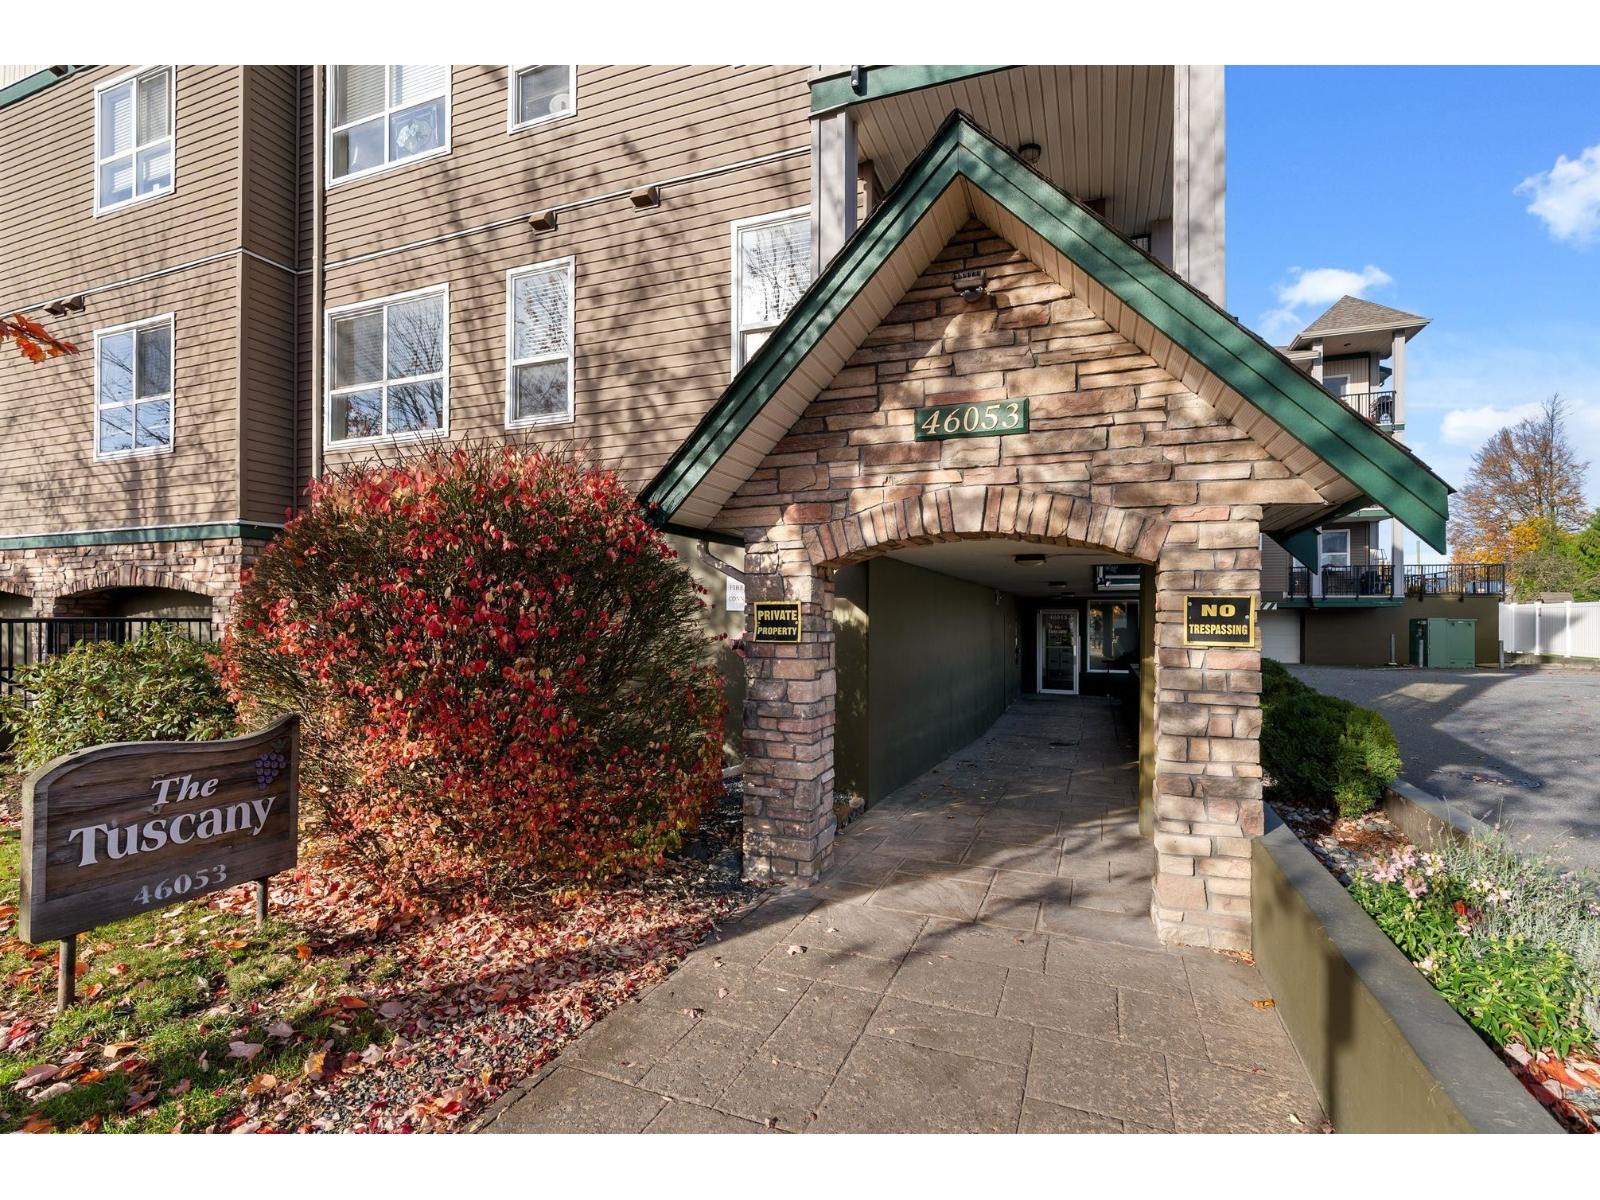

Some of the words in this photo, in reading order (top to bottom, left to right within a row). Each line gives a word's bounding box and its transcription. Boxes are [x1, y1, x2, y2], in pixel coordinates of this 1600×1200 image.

[921, 402, 1019, 434] 46053
[757, 609, 797, 621] PRIVATE
[1201, 604, 1236, 617] NO
[757, 626, 797, 636] PROPERTY
[1188, 623, 1248, 635] TRESPASSING
[151, 773, 219, 807] The
[68, 796, 277, 868] Tuscany
[133, 863, 228, 905] 46053
